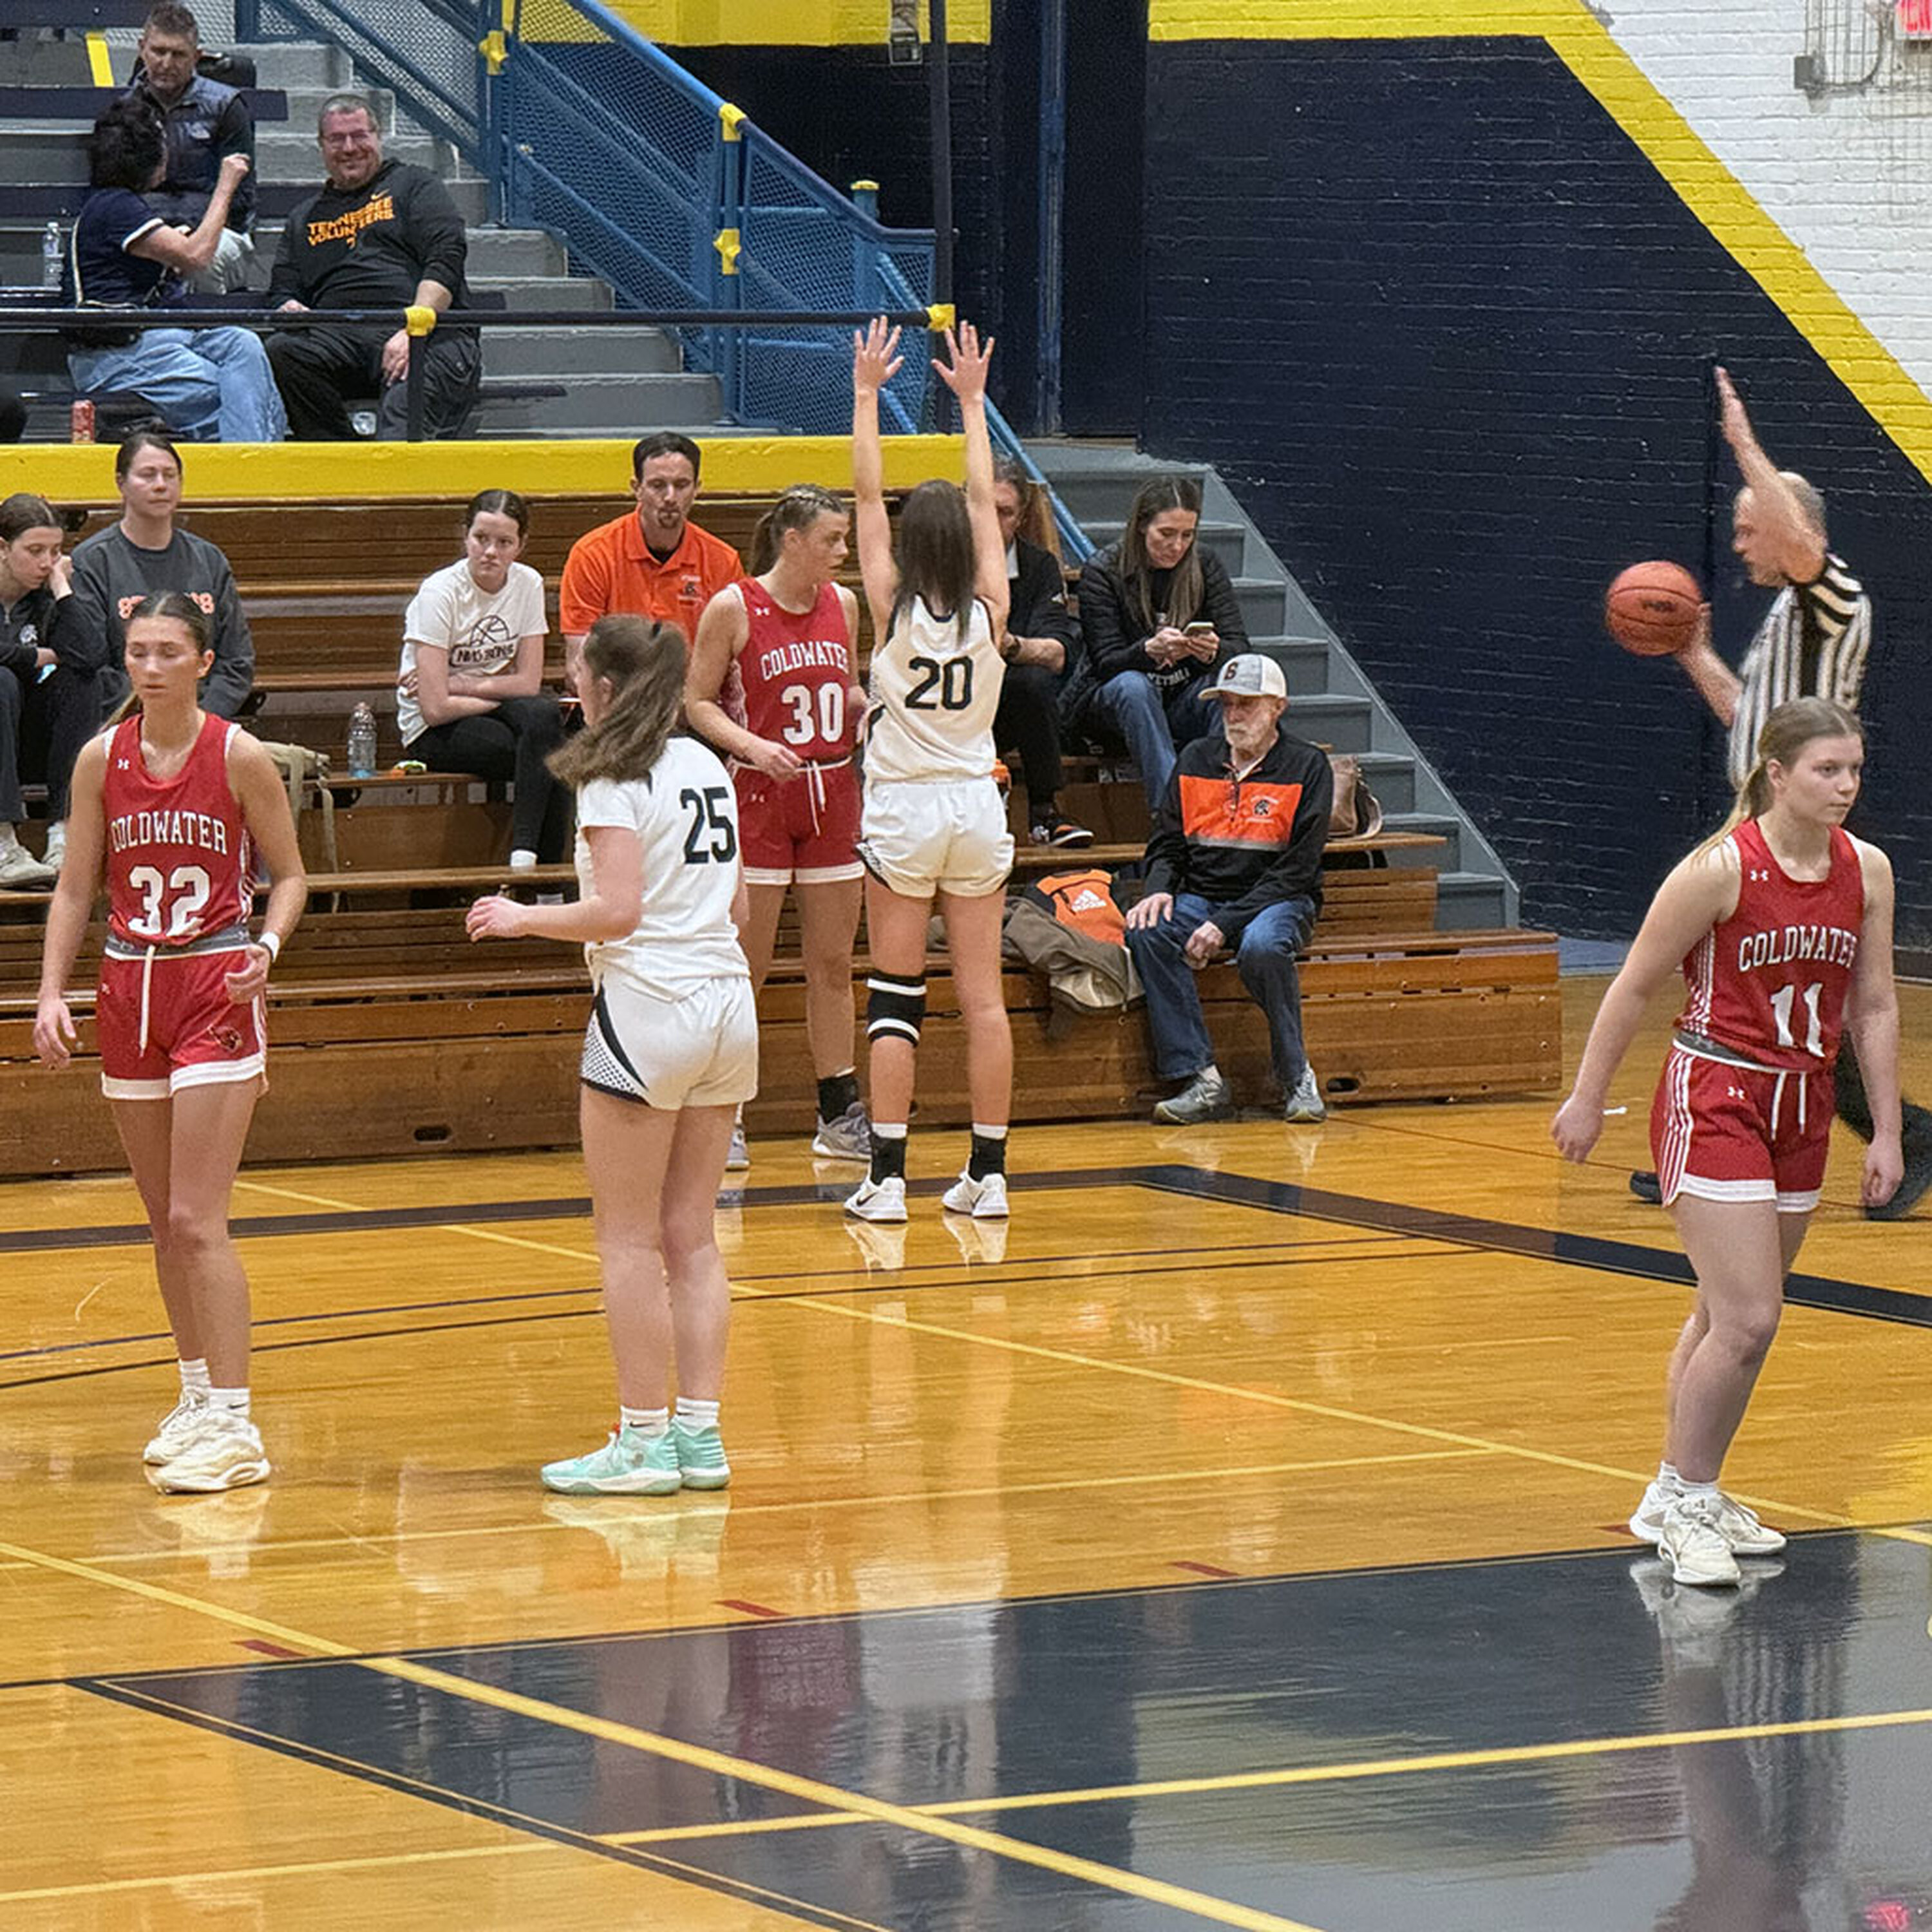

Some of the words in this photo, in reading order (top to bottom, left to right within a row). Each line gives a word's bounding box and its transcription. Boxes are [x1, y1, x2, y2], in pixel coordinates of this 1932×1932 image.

[781, 682, 844, 744] 30
[905, 656, 973, 710] 20
[679, 786, 737, 864] 25
[128, 866, 210, 937] 32
[1770, 982, 1826, 1057] 11
